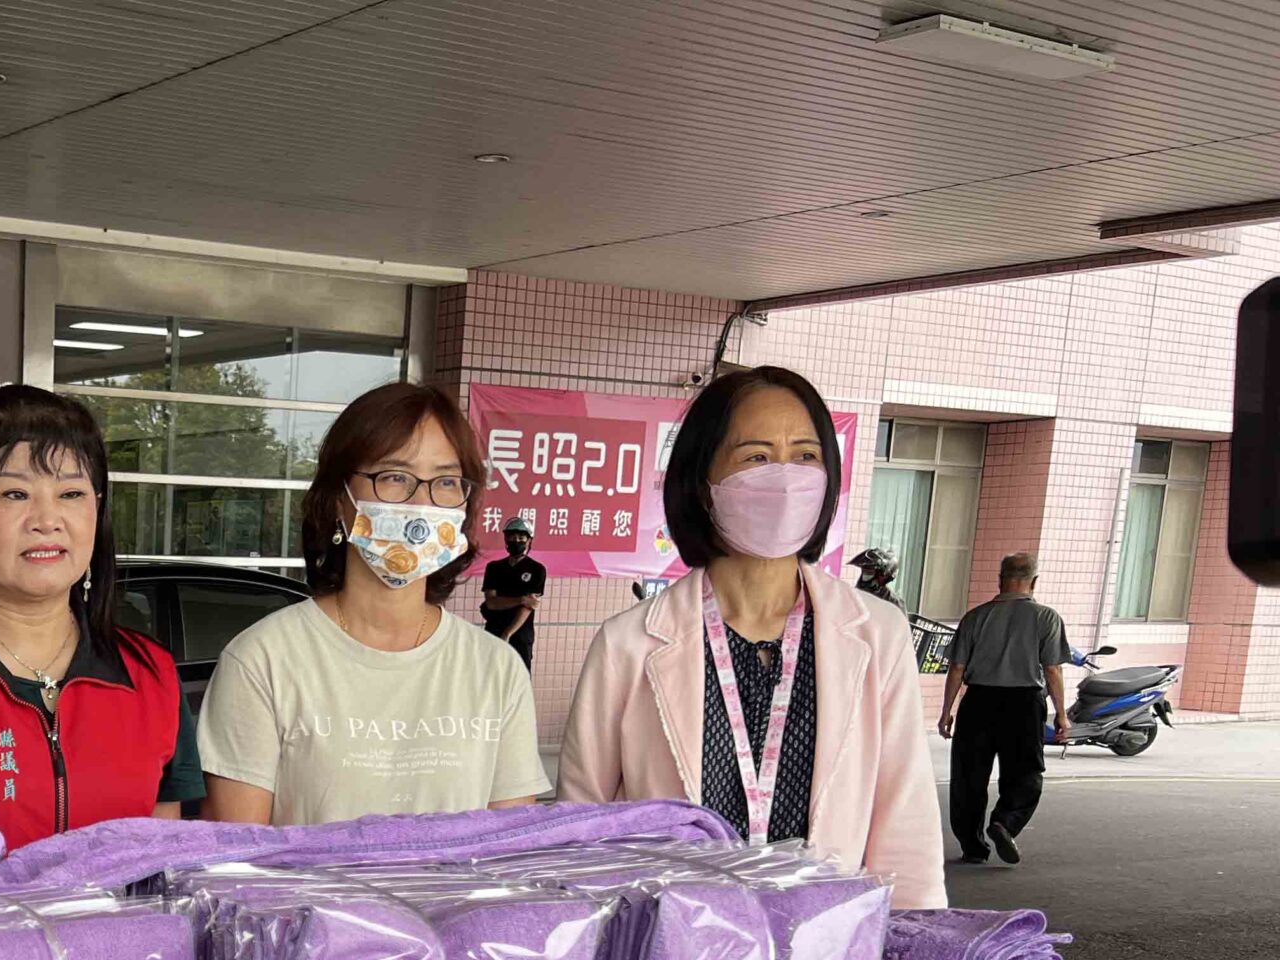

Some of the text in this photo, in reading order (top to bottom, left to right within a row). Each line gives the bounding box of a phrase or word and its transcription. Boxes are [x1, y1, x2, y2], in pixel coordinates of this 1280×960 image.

[486, 428, 642, 498] 長照2.0
[482, 507, 633, 538] 我們照顧您
[290, 714, 503, 743] AU PARADISE
